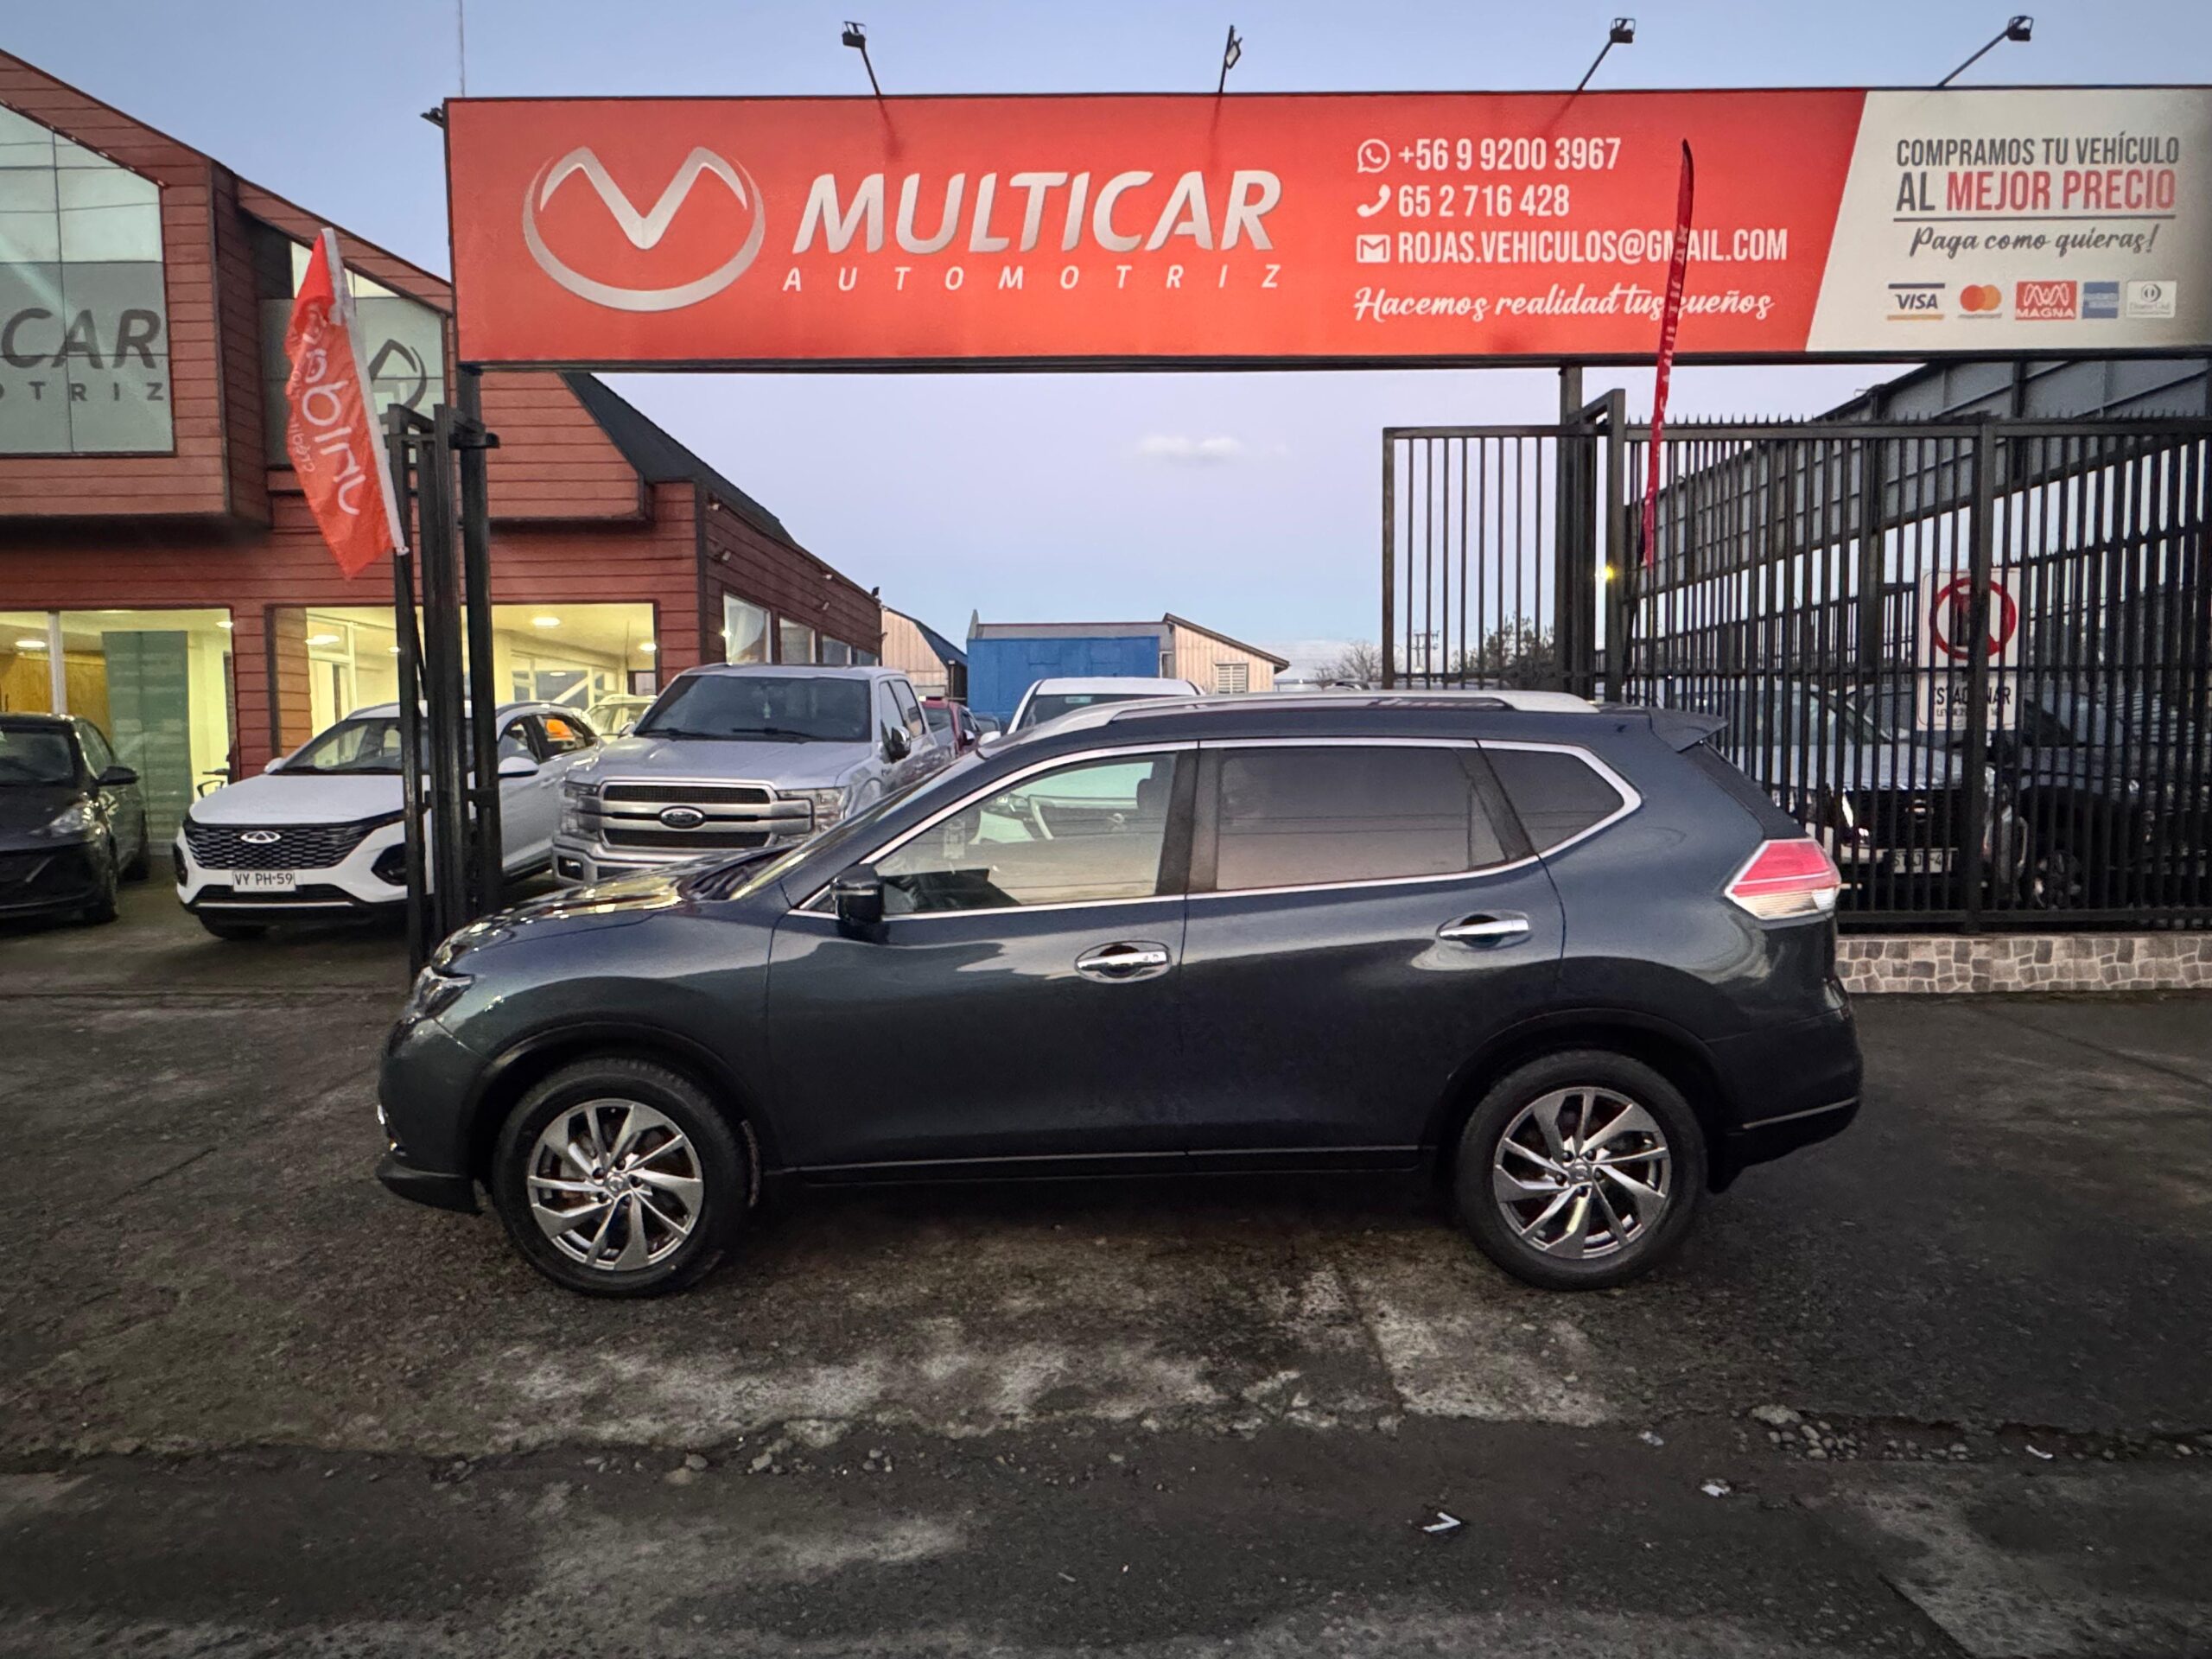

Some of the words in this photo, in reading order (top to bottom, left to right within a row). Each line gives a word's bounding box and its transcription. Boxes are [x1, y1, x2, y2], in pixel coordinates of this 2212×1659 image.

[1398, 138, 1449, 170] +56
[1456, 138, 1472, 170] 9
[1480, 138, 1547, 170] 9200
[1554, 137, 1621, 170] 3967
[1897, 138, 2036, 166] COMPRAMOS
[2042, 138, 2069, 165] TU
[2076, 131, 2179, 164] VEHÍCULO
[1398, 185, 1430, 217] 65
[1440, 185, 1455, 217] 2
[1464, 185, 1512, 217] 716
[1520, 184, 1570, 216] 428
[1896, 172, 1936, 212] AL
[1947, 170, 2051, 211] MEJOR
[2063, 168, 2176, 209] PRECIO
[791, 170, 1282, 255] MULTICAR
[1909, 226, 1979, 259] Paga
[1985, 232, 2051, 251] como
[2056, 223, 2160, 257] quieras!
[783, 264, 1282, 292] AUTOMOTRIZ
[1354, 287, 1491, 323] Hacemos
[1495, 283, 1621, 316] realidad
[1621, 283, 1666, 321] tus
[1895, 294, 1938, 310] VISA
[2016, 308, 2075, 319] MAGNA
[2, 308, 161, 369] CAR
[0, 381, 164, 402] TRIZ
[234, 873, 250, 886] VY
